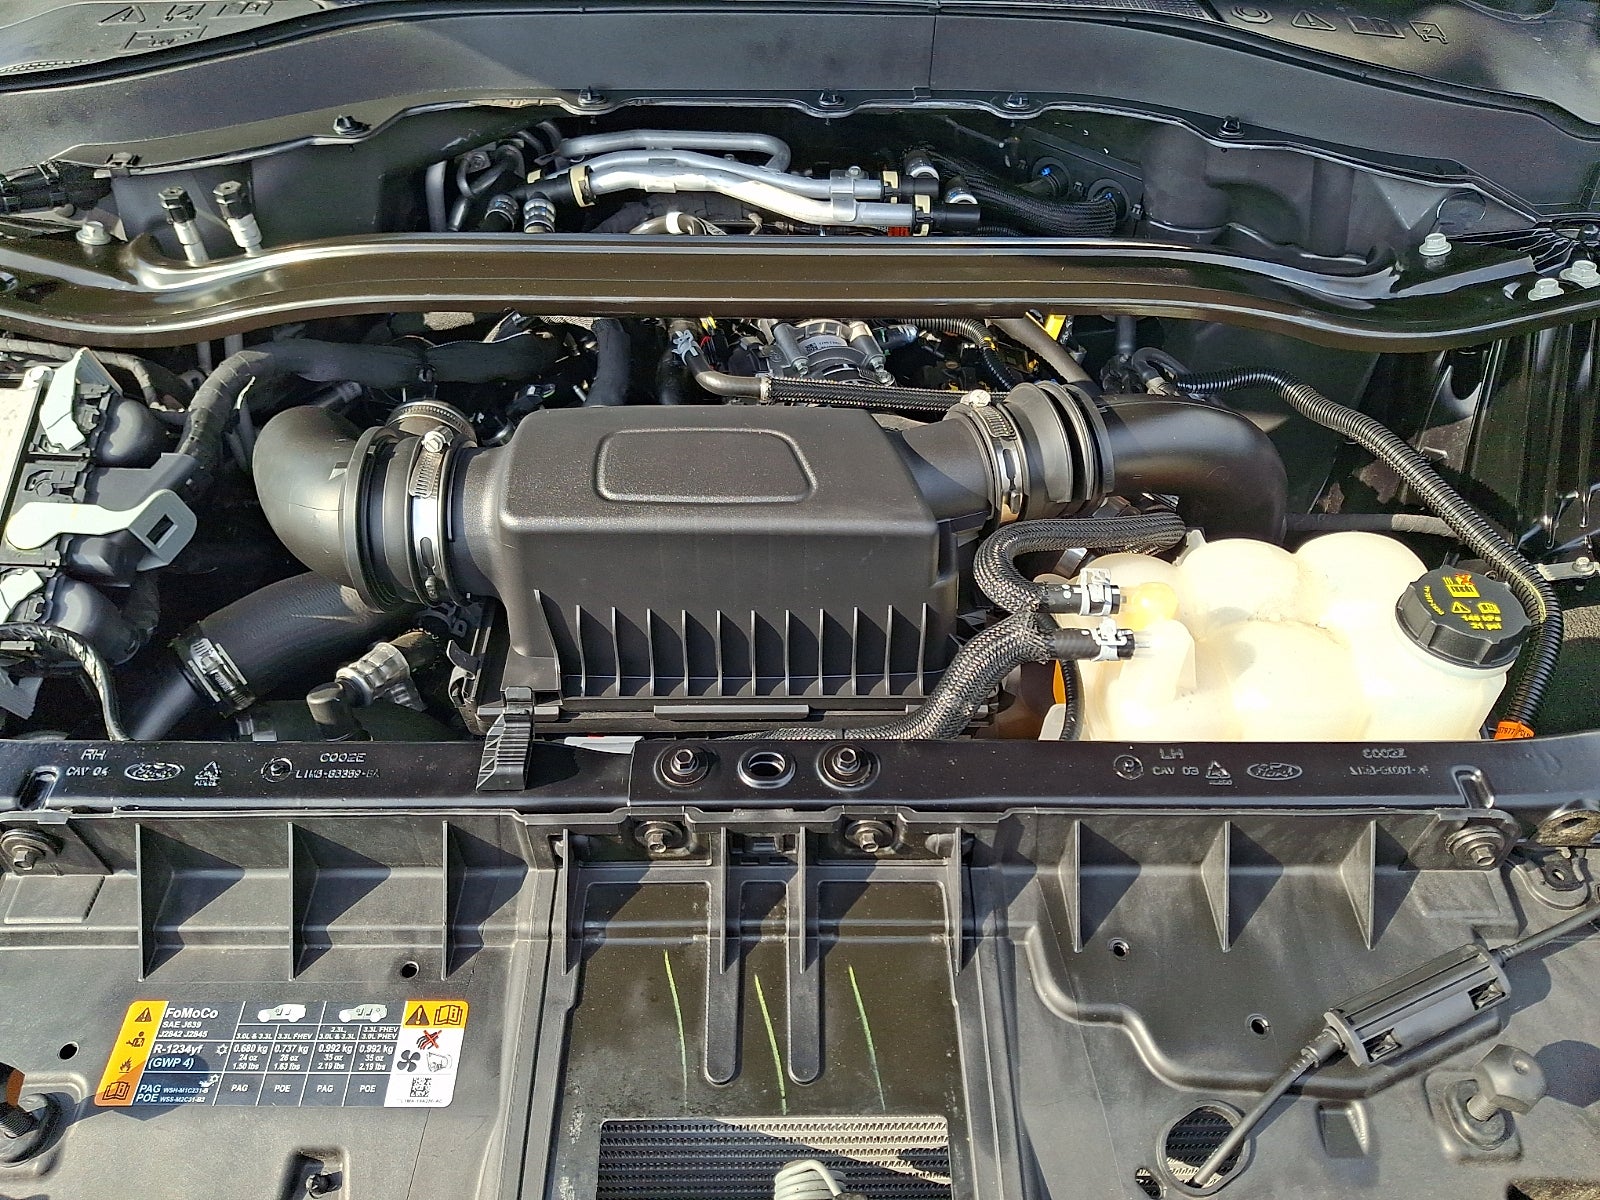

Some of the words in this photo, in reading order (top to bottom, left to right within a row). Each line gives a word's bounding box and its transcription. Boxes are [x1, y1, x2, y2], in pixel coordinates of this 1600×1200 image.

[81, 749, 107, 761] RH
[1159, 748, 1184, 760] LH
[164, 1007, 219, 1019] FoMoCo
[162, 1021, 181, 1029] SAE
[181, 1021, 202, 1029] J639
[153, 1043, 203, 1056] R-1234yf
[233, 1044, 256, 1053] 0.680
[257, 1044, 269, 1055] kg
[274, 1044, 297, 1053] 0.737
[298, 1044, 309, 1056] kg
[318, 1044, 341, 1053] 0.992
[342, 1044, 353, 1055] kg
[359, 1044, 382, 1053] 0.992
[383, 1044, 394, 1055] kg
[238, 1053, 248, 1061] 24
[323, 1053, 334, 1061] 35
[365, 1054, 375, 1062] 35
[148, 1057, 181, 1069] (GWP
[183, 1057, 195, 1069] 4)
[232, 1062, 247, 1070] 1.50
[248, 1062, 260, 1070] lbs
[289, 1063, 301, 1071] lbs
[317, 1062, 333, 1070] 2.19
[375, 1063, 387, 1071] lbs
[139, 1084, 161, 1093] PAG
[231, 1084, 249, 1092] PAG
[274, 1084, 291, 1092] POE
[316, 1085, 334, 1093] PAG
[359, 1084, 377, 1093] POE
[136, 1093, 159, 1102] POE
